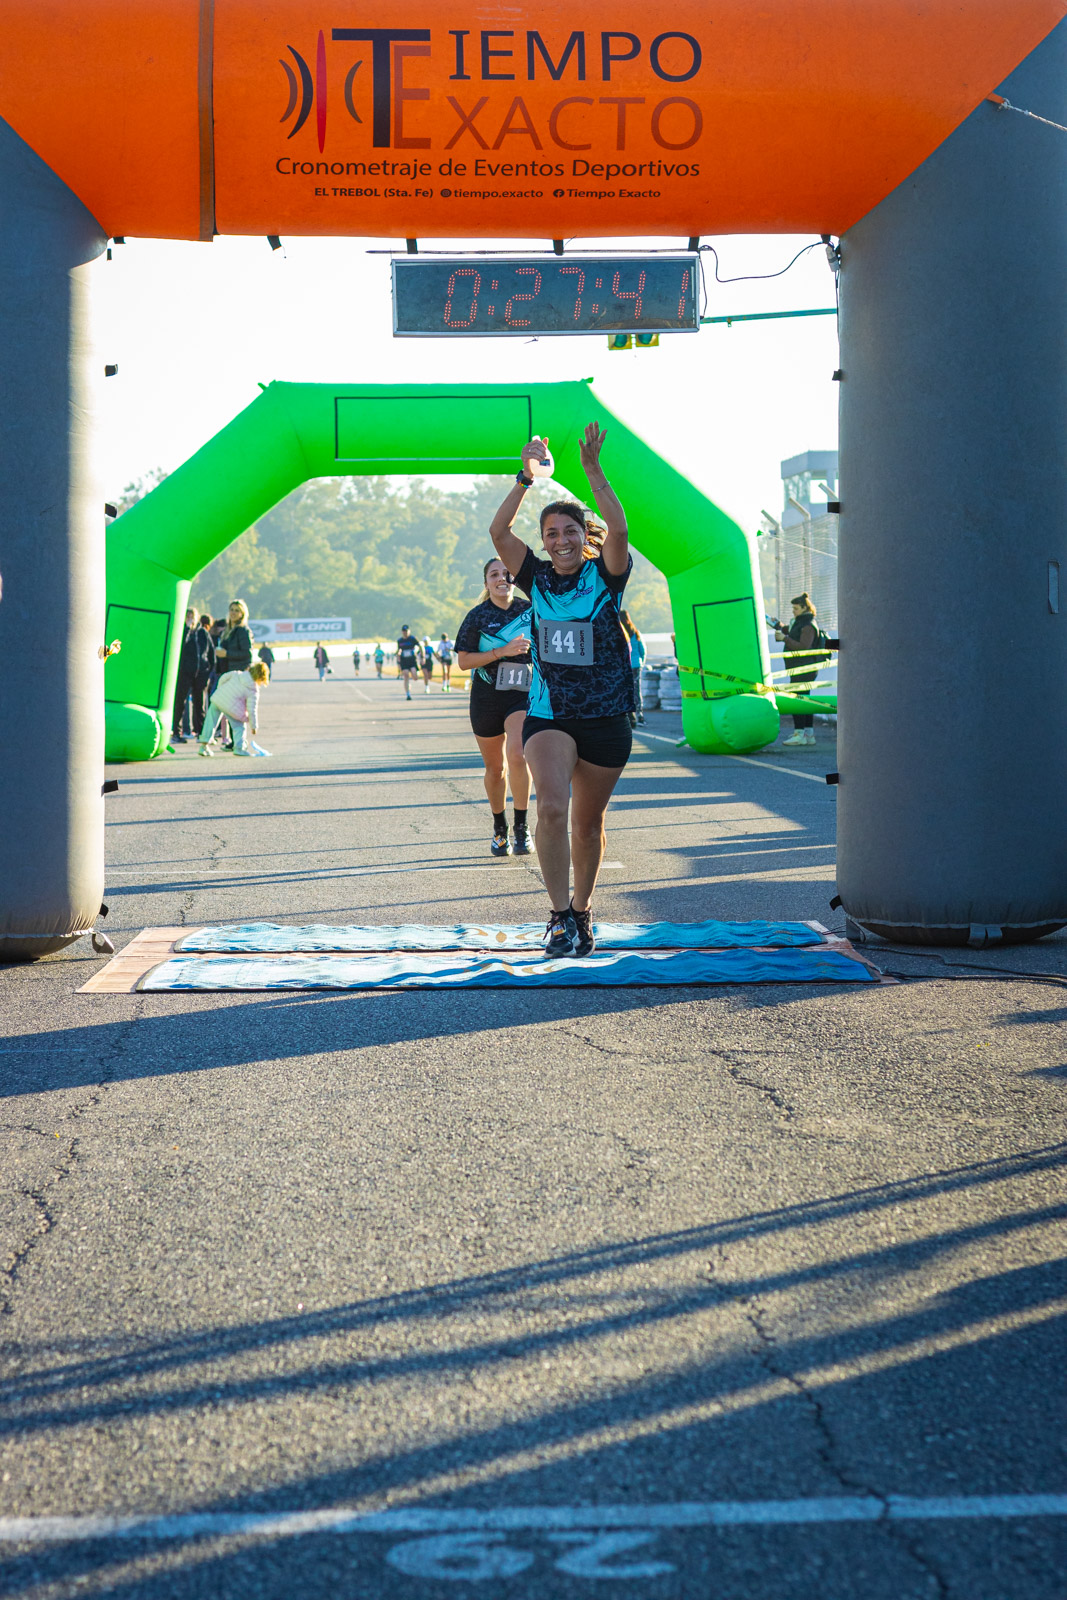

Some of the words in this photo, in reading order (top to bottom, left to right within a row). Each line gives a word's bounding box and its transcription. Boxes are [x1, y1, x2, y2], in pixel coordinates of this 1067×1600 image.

[275, 157, 432, 180] Cronometraje
[438, 158, 467, 176] de
[474, 159, 565, 177] Eventos
[572, 159, 700, 181] Deportivos
[314, 187, 329, 197] EL
[332, 187, 381, 197] TREBOL
[383, 188, 412, 198] (Sta.
[415, 189, 434, 199] Fe)
[453, 189, 544, 200] tiempo.exacto
[567, 188, 616, 199] Tiempo
[618, 189, 661, 198] Exacto
[444, 268, 689, 327] 0:27:41
[297, 623, 342, 631] LONG
[551, 630, 575, 654] 44
[508, 669, 523, 685] 11
